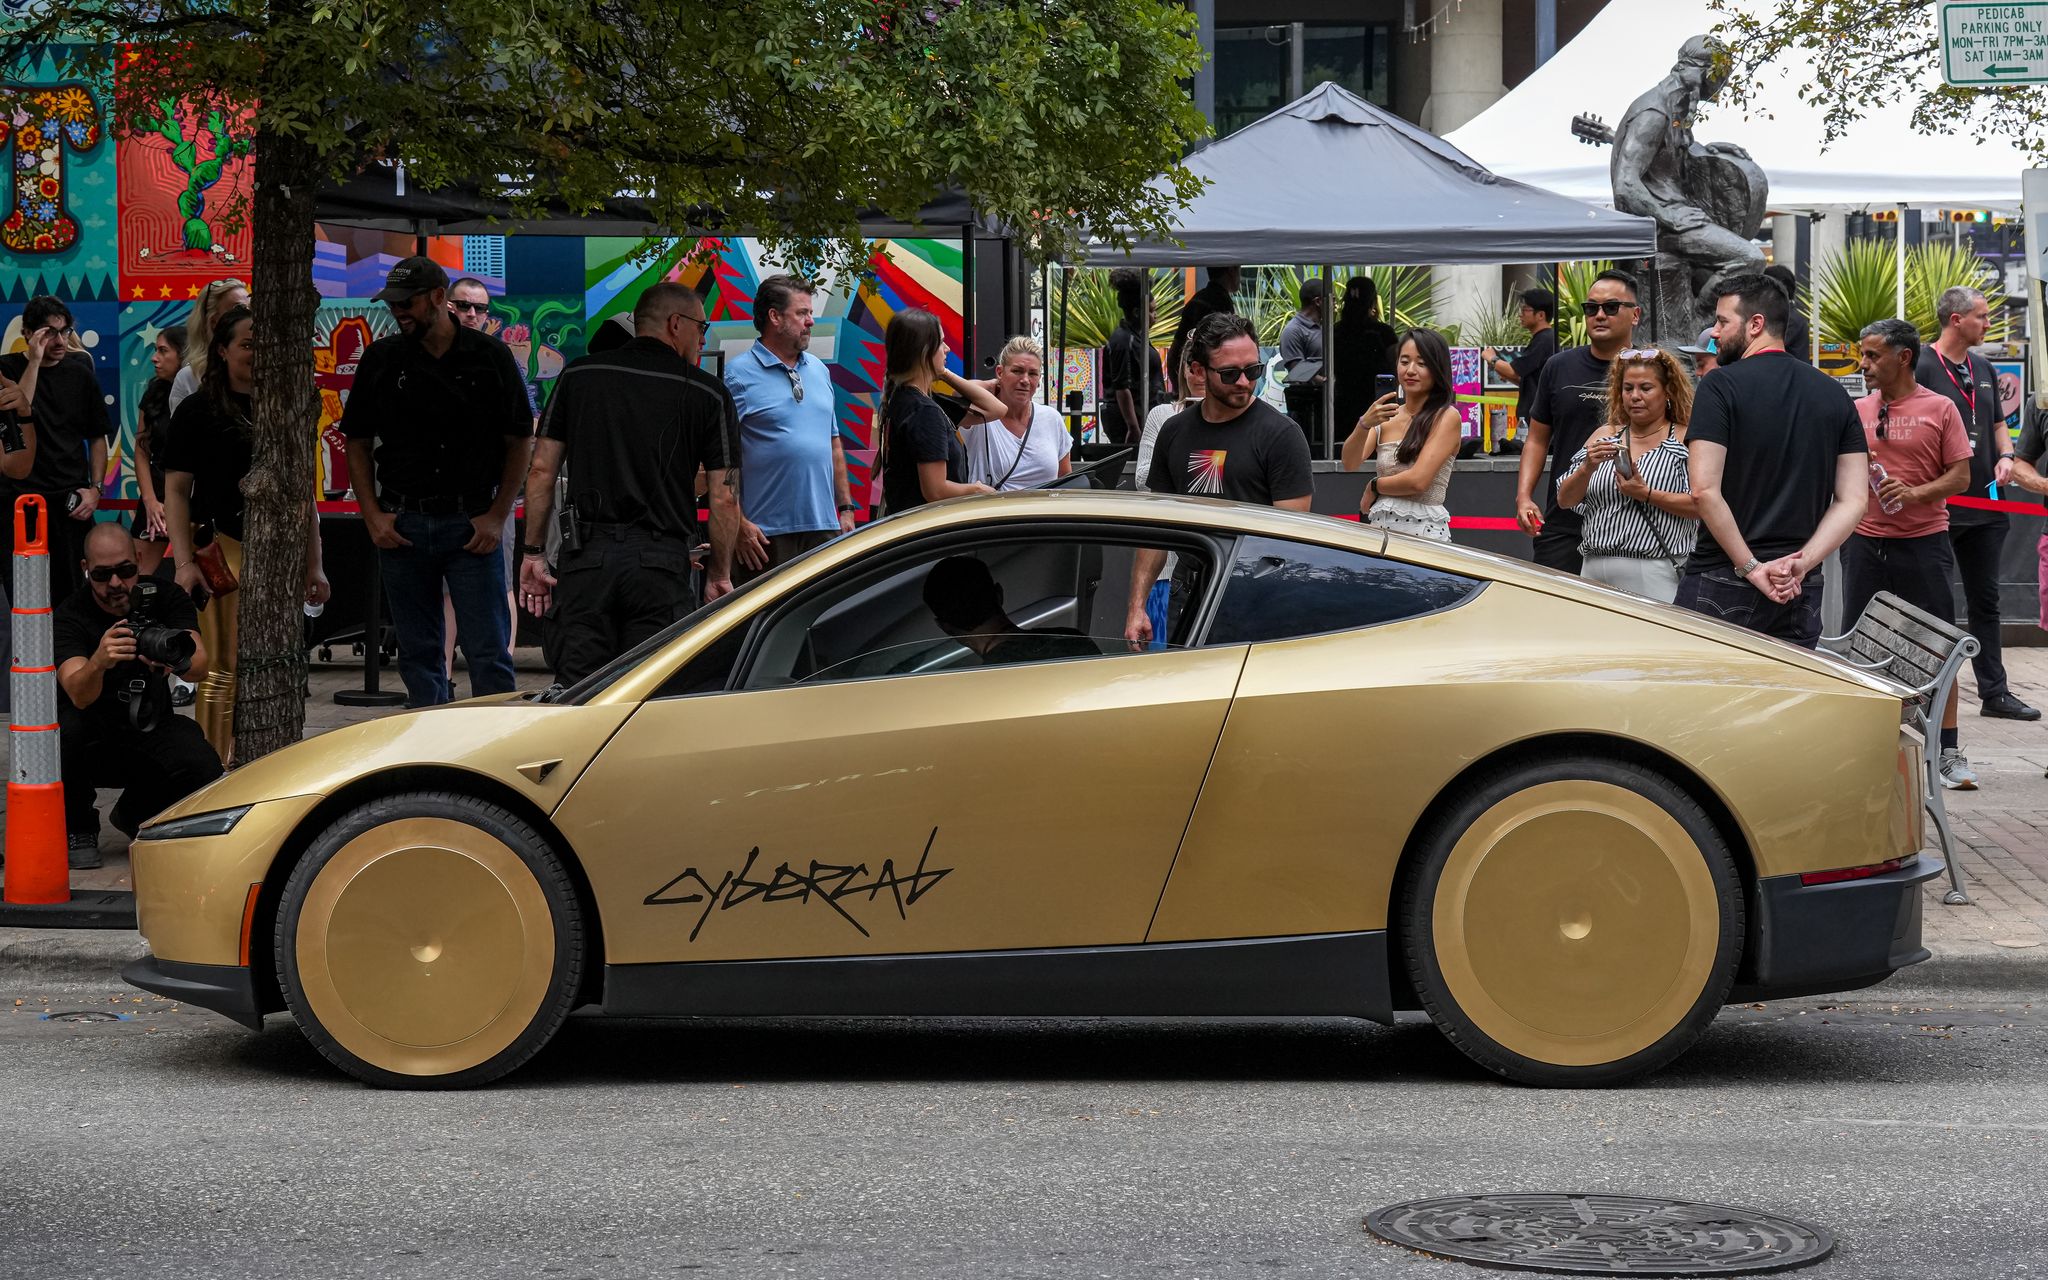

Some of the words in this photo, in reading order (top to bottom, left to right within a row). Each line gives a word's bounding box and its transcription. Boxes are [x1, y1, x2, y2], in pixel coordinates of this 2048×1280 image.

[1978, 7, 2025, 20] PEDICAB
[1961, 22, 2009, 34] PARKING
[2014, 20, 2042, 33] ONLY
[1952, 36, 1999, 48] MON-FRI
[2003, 35, 2048, 47] 7PM-3A
[1965, 50, 1984, 62] SAT
[1989, 49, 2044, 62] 11AM-3AM
